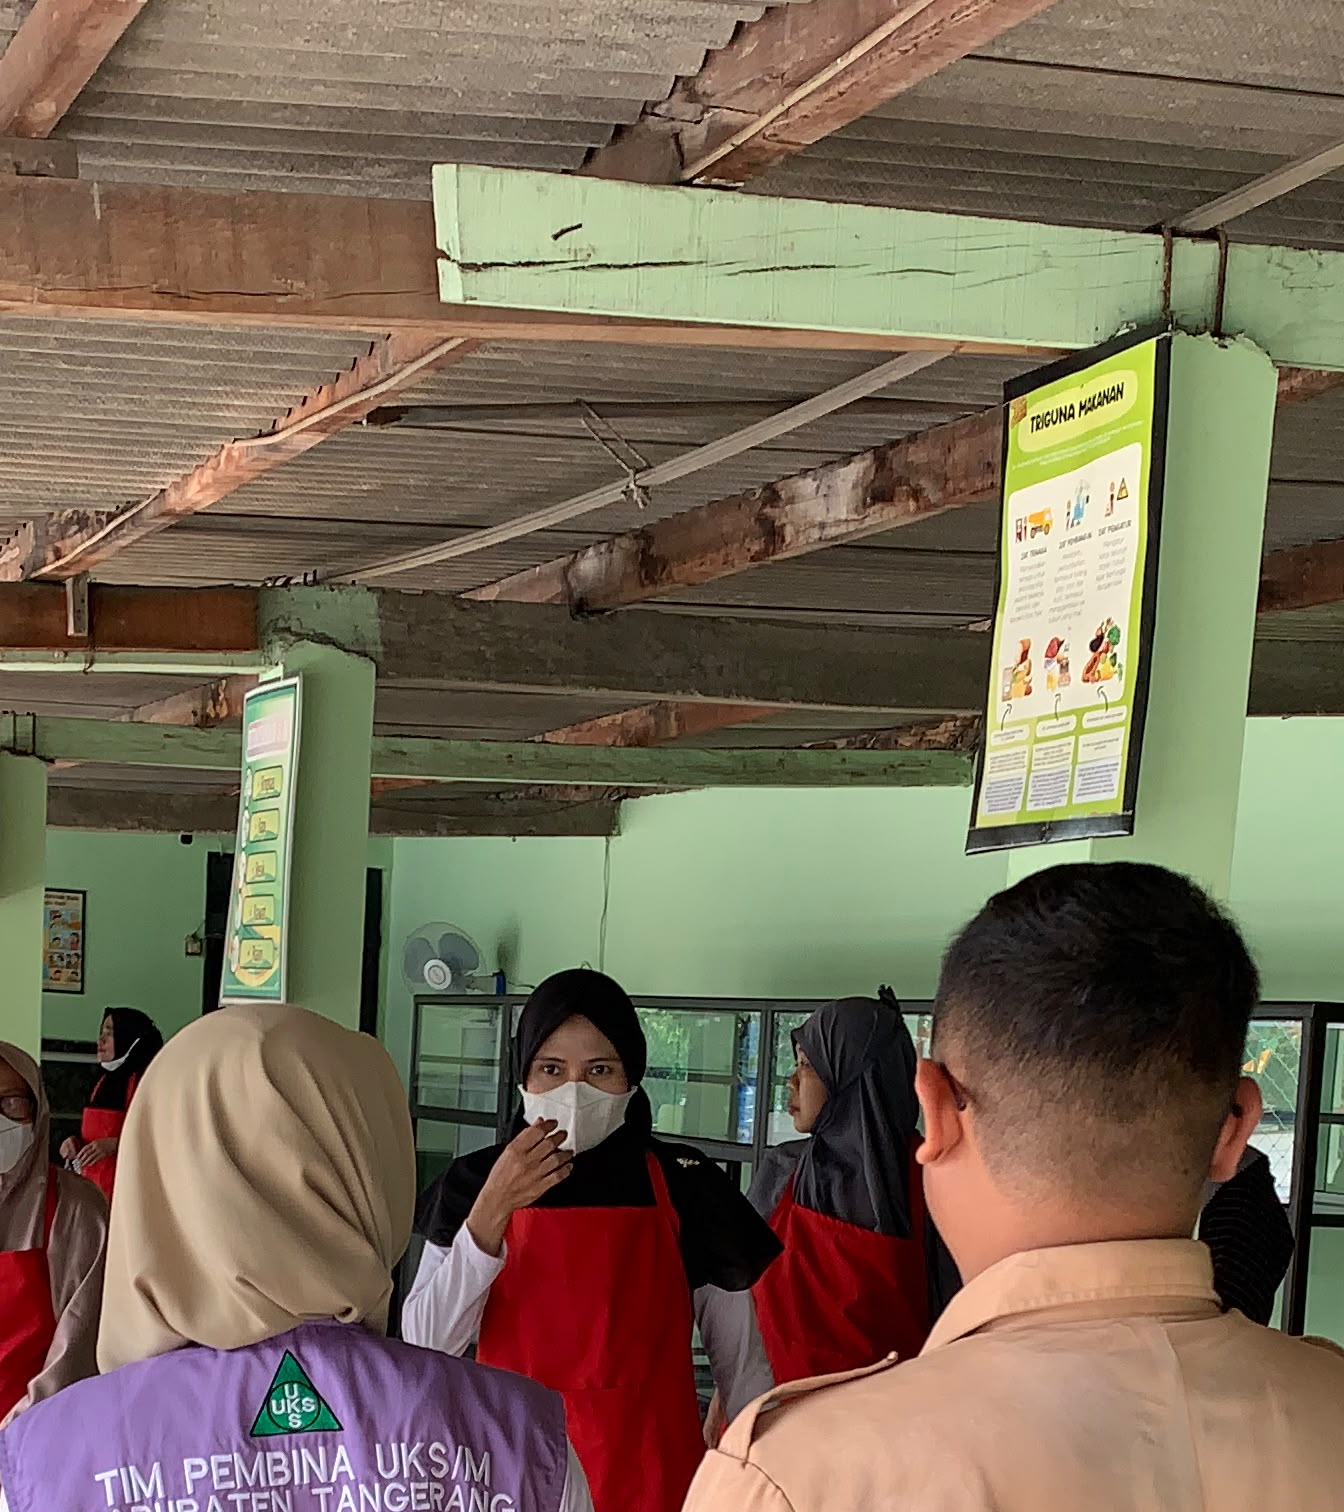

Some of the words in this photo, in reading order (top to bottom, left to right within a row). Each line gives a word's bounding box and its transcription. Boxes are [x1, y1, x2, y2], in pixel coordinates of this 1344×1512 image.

[1030, 402, 1076, 434] TRIGUNA
[1078, 381, 1125, 418] MAKANAN
[271, 1396, 316, 1415] UKS
[94, 1461, 166, 1507] TIM
[183, 1444, 356, 1496] PEMBINA
[375, 1441, 491, 1488] UKS/M
